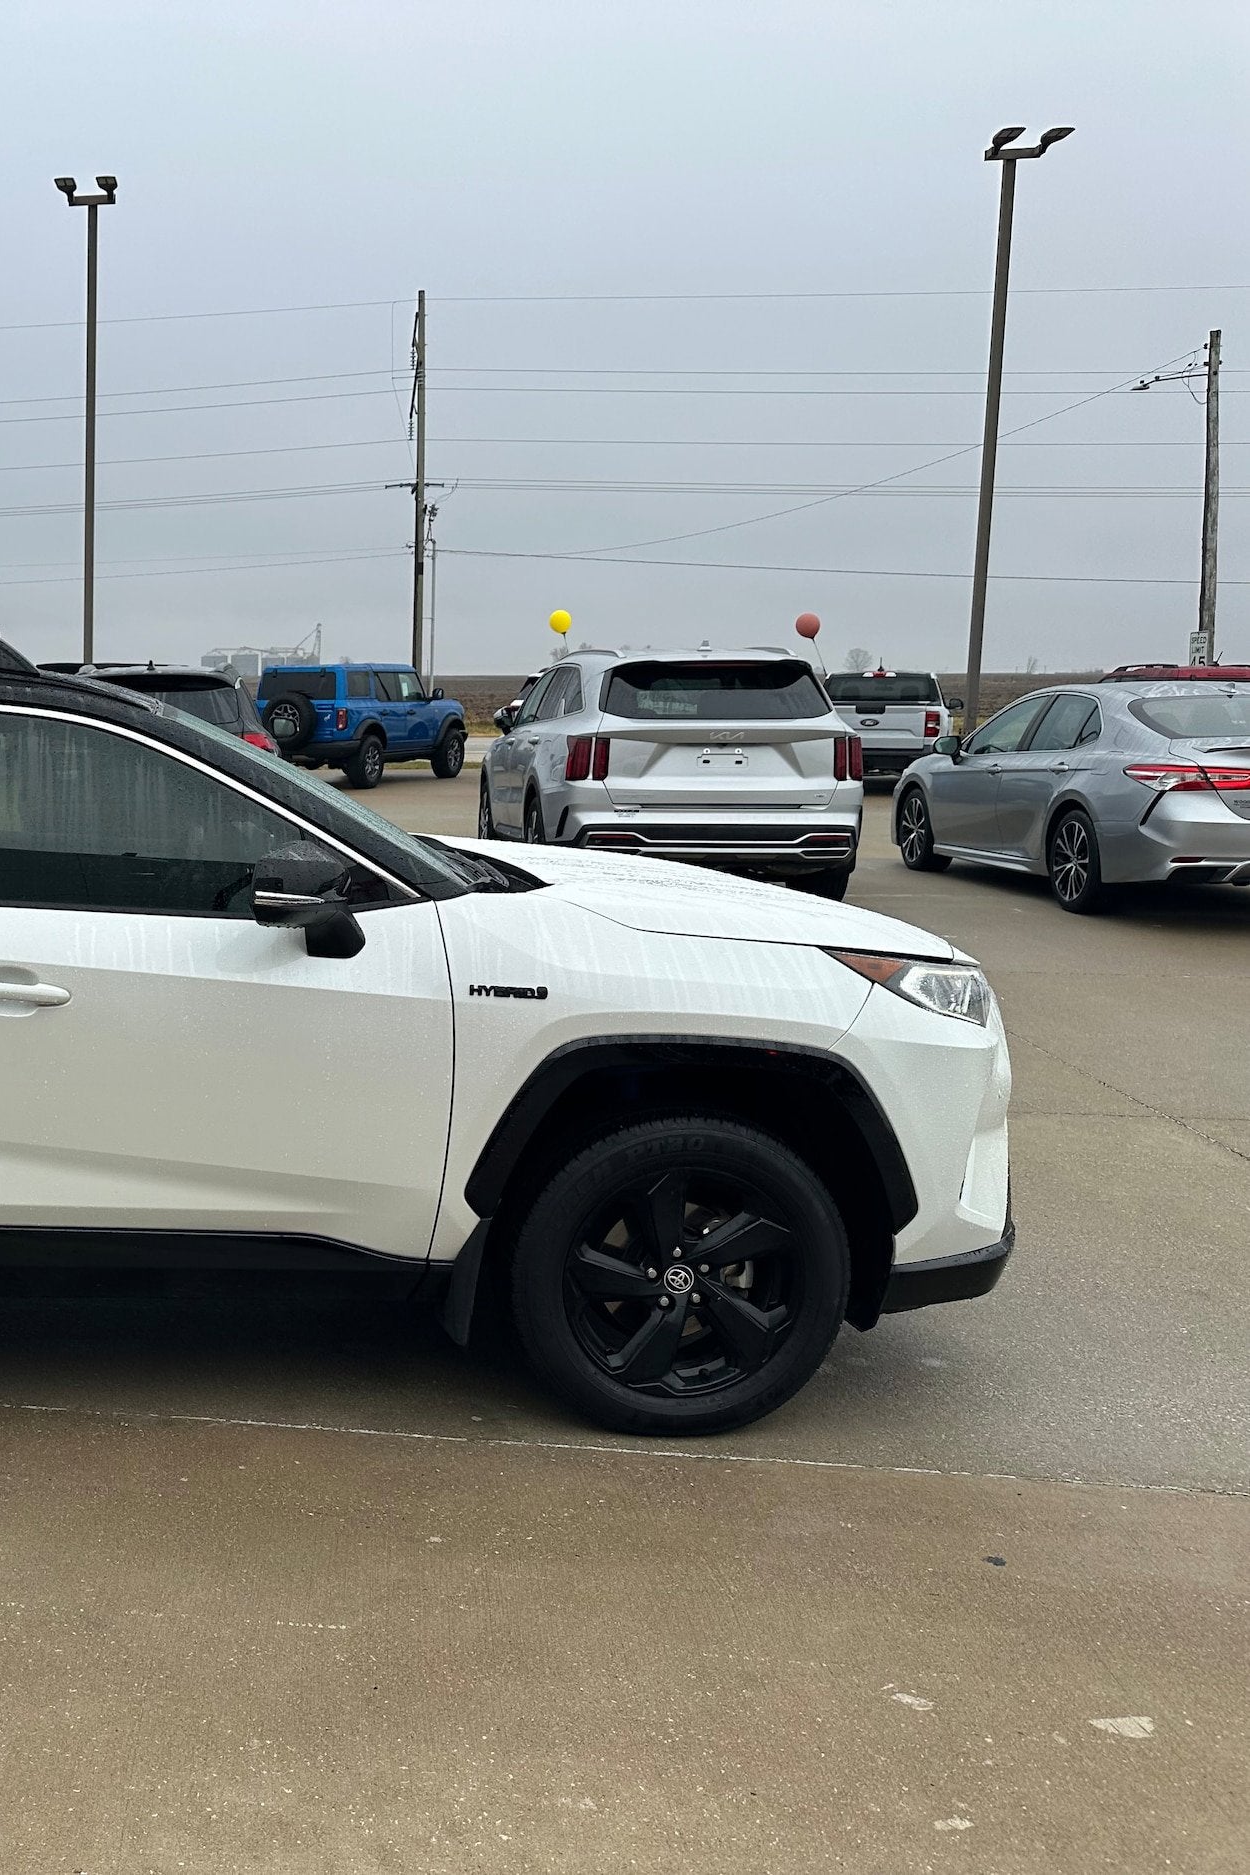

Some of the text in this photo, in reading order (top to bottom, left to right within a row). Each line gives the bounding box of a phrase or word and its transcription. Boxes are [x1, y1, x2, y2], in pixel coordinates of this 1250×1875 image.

[1191, 636, 1207, 645] SPEED
[1191, 646, 1205, 654] LIMIT
[469, 985, 536, 999] HYBRID
